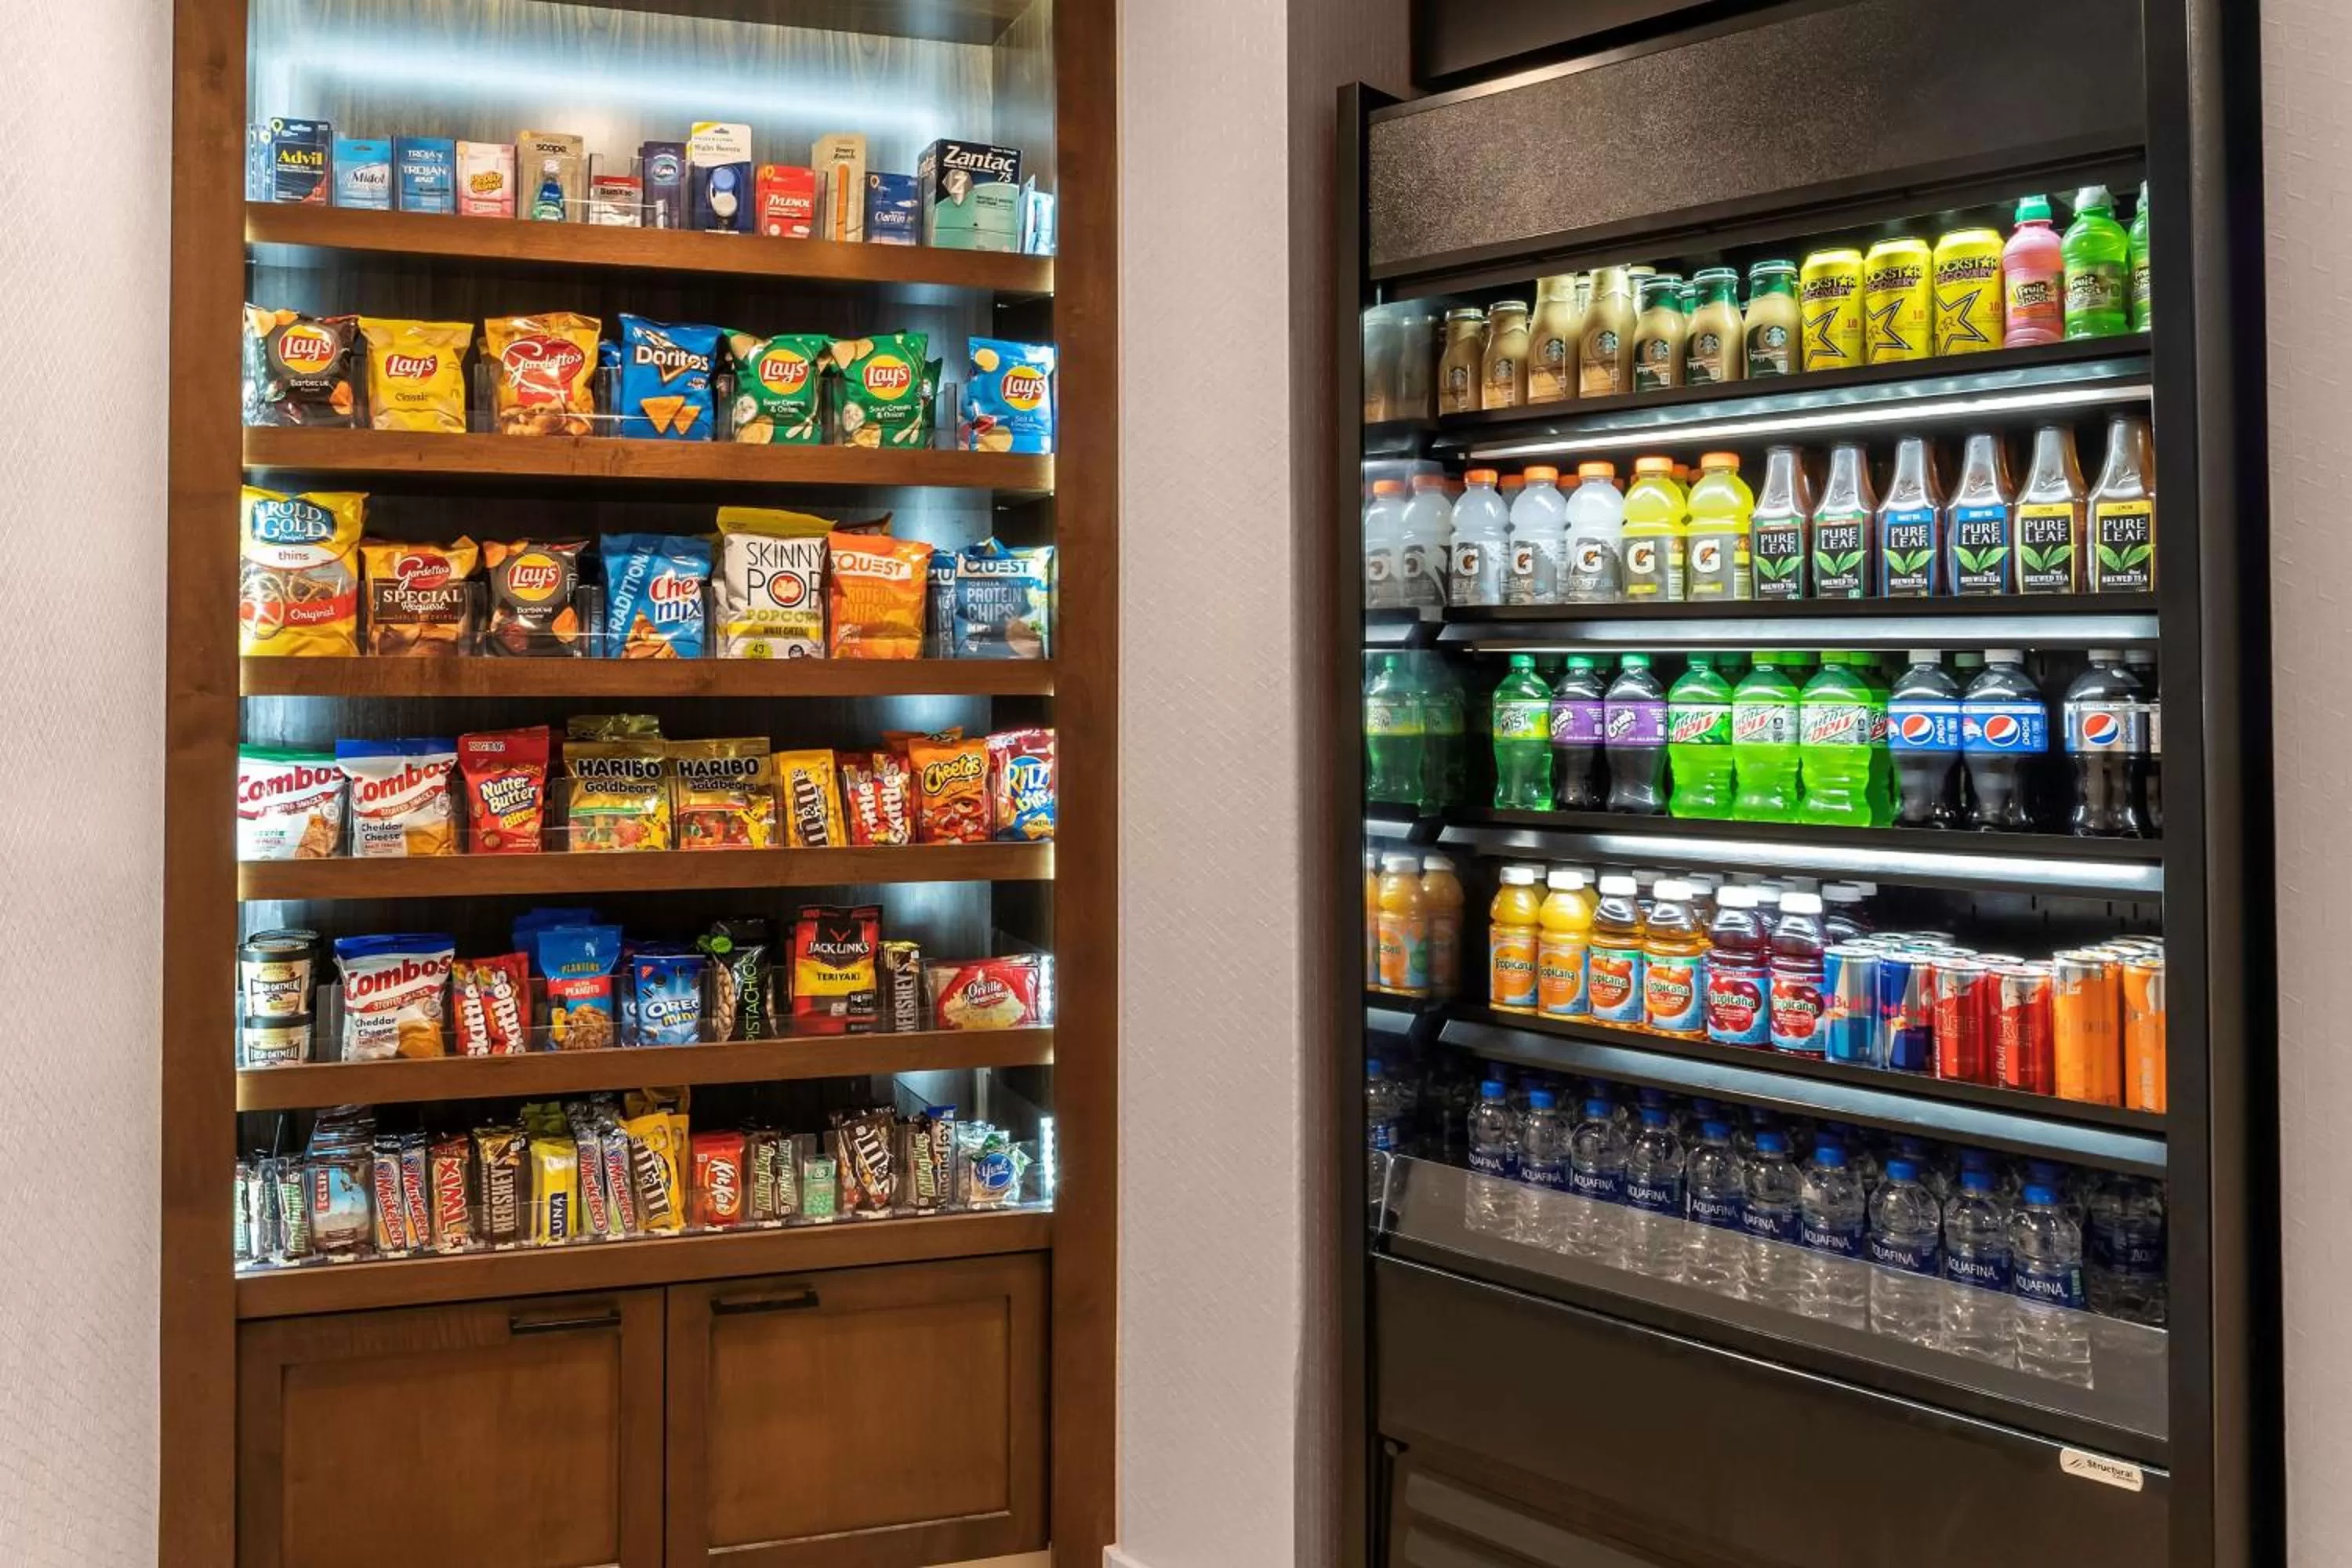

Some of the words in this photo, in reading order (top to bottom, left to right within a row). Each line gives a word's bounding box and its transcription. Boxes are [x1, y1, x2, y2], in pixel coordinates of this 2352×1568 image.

[277, 150, 323, 166] Advil
[535, 144, 568, 154] scope
[942, 146, 1017, 174] Zantac
[351, 170, 386, 183] Midol
[402, 165, 447, 176] TROJAN
[997, 172, 1012, 183] 75
[768, 194, 811, 208] TYLENOL
[2016, 283, 2045, 297] Fruit
[2071, 275, 2094, 290] Fruit
[284, 335, 331, 361] Lay's
[387, 355, 435, 378] Lay's
[636, 345, 709, 372] Doritos
[764, 359, 805, 383] Lay's
[868, 365, 907, 389] Lay's
[290, 379, 329, 388] Barbecue
[1006, 378, 1045, 400] Lay's
[394, 393, 427, 402] Classic
[266, 499, 324, 524] ROLD
[262, 517, 328, 539] GOLD
[1821, 527, 1857, 539] PURE
[1890, 524, 1928, 537] PURE
[1962, 521, 2002, 534] PURE
[2024, 519, 2067, 532] PURE
[2103, 517, 2146, 532] PURE
[1760, 533, 1796, 544] PURE
[1821, 538, 1858, 550] LEAF
[1890, 536, 1928, 549] LEAF
[1962, 533, 2002, 546] LEAF
[2024, 531, 2067, 544] LEAF
[2103, 530, 2147, 544] LEAF
[278, 550, 310, 561] thins
[1577, 543, 1602, 574] G
[1627, 540, 1655, 575] G
[1692, 539, 1721, 573] G
[1760, 543, 1796, 555] LEAF
[837, 552, 904, 577] QUEST
[964, 560, 1029, 574] QUEST
[1457, 546, 1479, 575] G
[1512, 546, 1533, 575] G
[513, 567, 558, 589] Lay's
[2132, 574, 2148, 583] TEA
[383, 589, 464, 603] SPECIAL
[651, 575, 699, 602] Chex
[967, 587, 1022, 603] PROTEIN
[289, 606, 335, 622] Original
[967, 603, 1015, 623] CHIPS
[752, 644, 764, 654] 43
[1936, 716, 1947, 744] pepsi
[2020, 717, 2031, 745] pepsi
[576, 758, 662, 779] HARIBO
[677, 757, 760, 779] HARIBO
[923, 753, 984, 796] Cheetos
[238, 765, 346, 803] Combos
[351, 757, 457, 804] Combos
[479, 774, 529, 800] Nutter
[584, 780, 658, 795] Goldbears
[1004, 763, 1051, 797] RITZ
[488, 785, 538, 814] Butter
[880, 761, 909, 845] Skittles
[361, 822, 402, 833] Cheddar
[808, 942, 836, 956] JACK
[837, 942, 869, 956] LINK'S
[1495, 957, 1534, 972] Tropicana
[1539, 965, 1575, 981] Tropicana
[345, 953, 453, 1002] Combos
[817, 971, 860, 982] TERIYAKI
[967, 979, 1003, 999] Orville
[1710, 990, 1754, 1009] Tropicana
[1772, 996, 1817, 1013] Tropicana
[648, 1000, 700, 1019] OREO
[355, 1016, 396, 1029] Cheddar
[936, 1121, 951, 1148] Joy
[1573, 1174, 1616, 1193] AQUAFINA
[437, 1159, 468, 1232] TWIX
[492, 1156, 515, 1234] HERSHEY'S
[579, 1159, 608, 1232] Musketeers
[403, 1173, 430, 1247] Musketeers
[550, 1196, 565, 1238] LUNA
[1692, 1200, 1738, 1218] AQUAFINA
[1947, 1255, 1998, 1280] AQUAFINA
[2015, 1273, 2068, 1298] AQUAFINA
[2087, 1459, 2134, 1479] Structural
